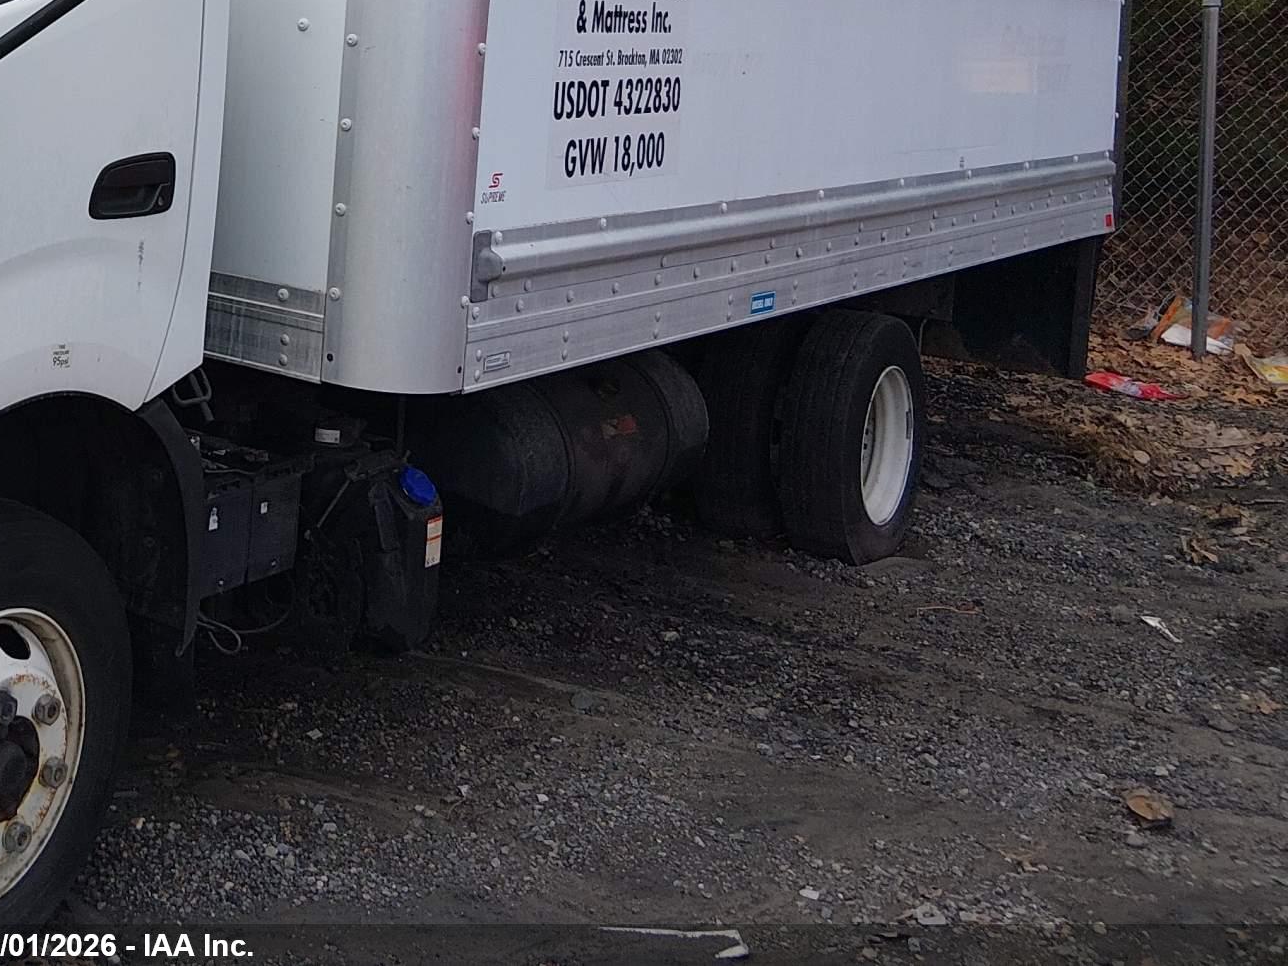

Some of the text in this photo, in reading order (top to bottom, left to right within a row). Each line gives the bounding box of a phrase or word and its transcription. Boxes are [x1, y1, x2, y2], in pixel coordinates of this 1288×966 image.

[576, 0, 672, 34] & Mattress Inc.
[558, 50, 574, 67] 715
[575, 49, 604, 67] Crescent
[606, 49, 616, 66] St.
[617, 47, 647, 68] Brockton,
[649, 48, 660, 65] MA
[553, 76, 681, 120] USDOT 4322830
[564, 131, 665, 179] GVW 18,000
